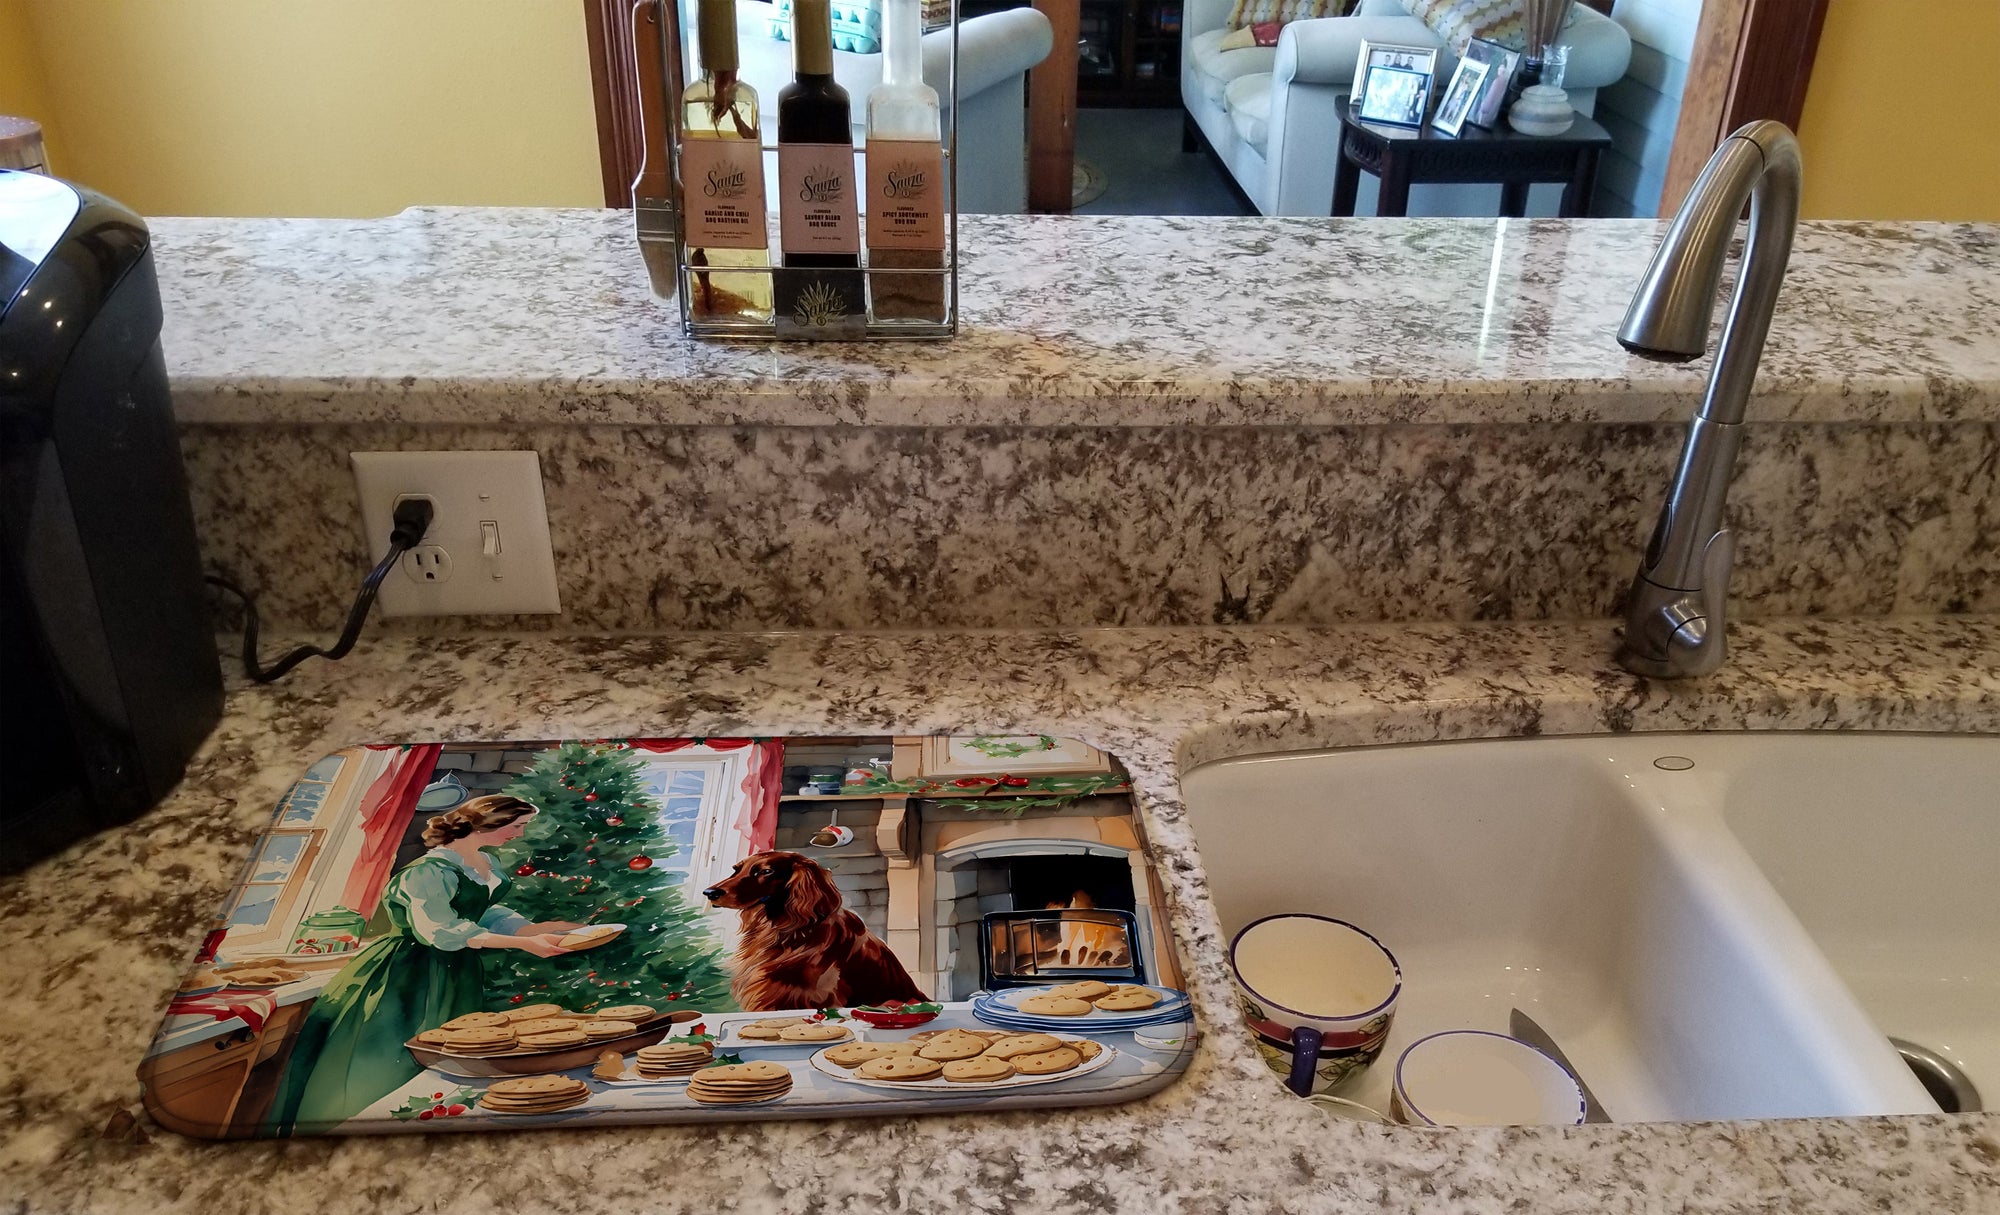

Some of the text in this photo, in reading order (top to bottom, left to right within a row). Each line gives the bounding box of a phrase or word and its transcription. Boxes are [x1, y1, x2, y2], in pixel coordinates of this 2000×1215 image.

[704, 170, 744, 197] Sauza
[800, 175, 841, 202] Sauza
[883, 171, 923, 198] Sauza
[793, 295, 842, 326] Sauza
